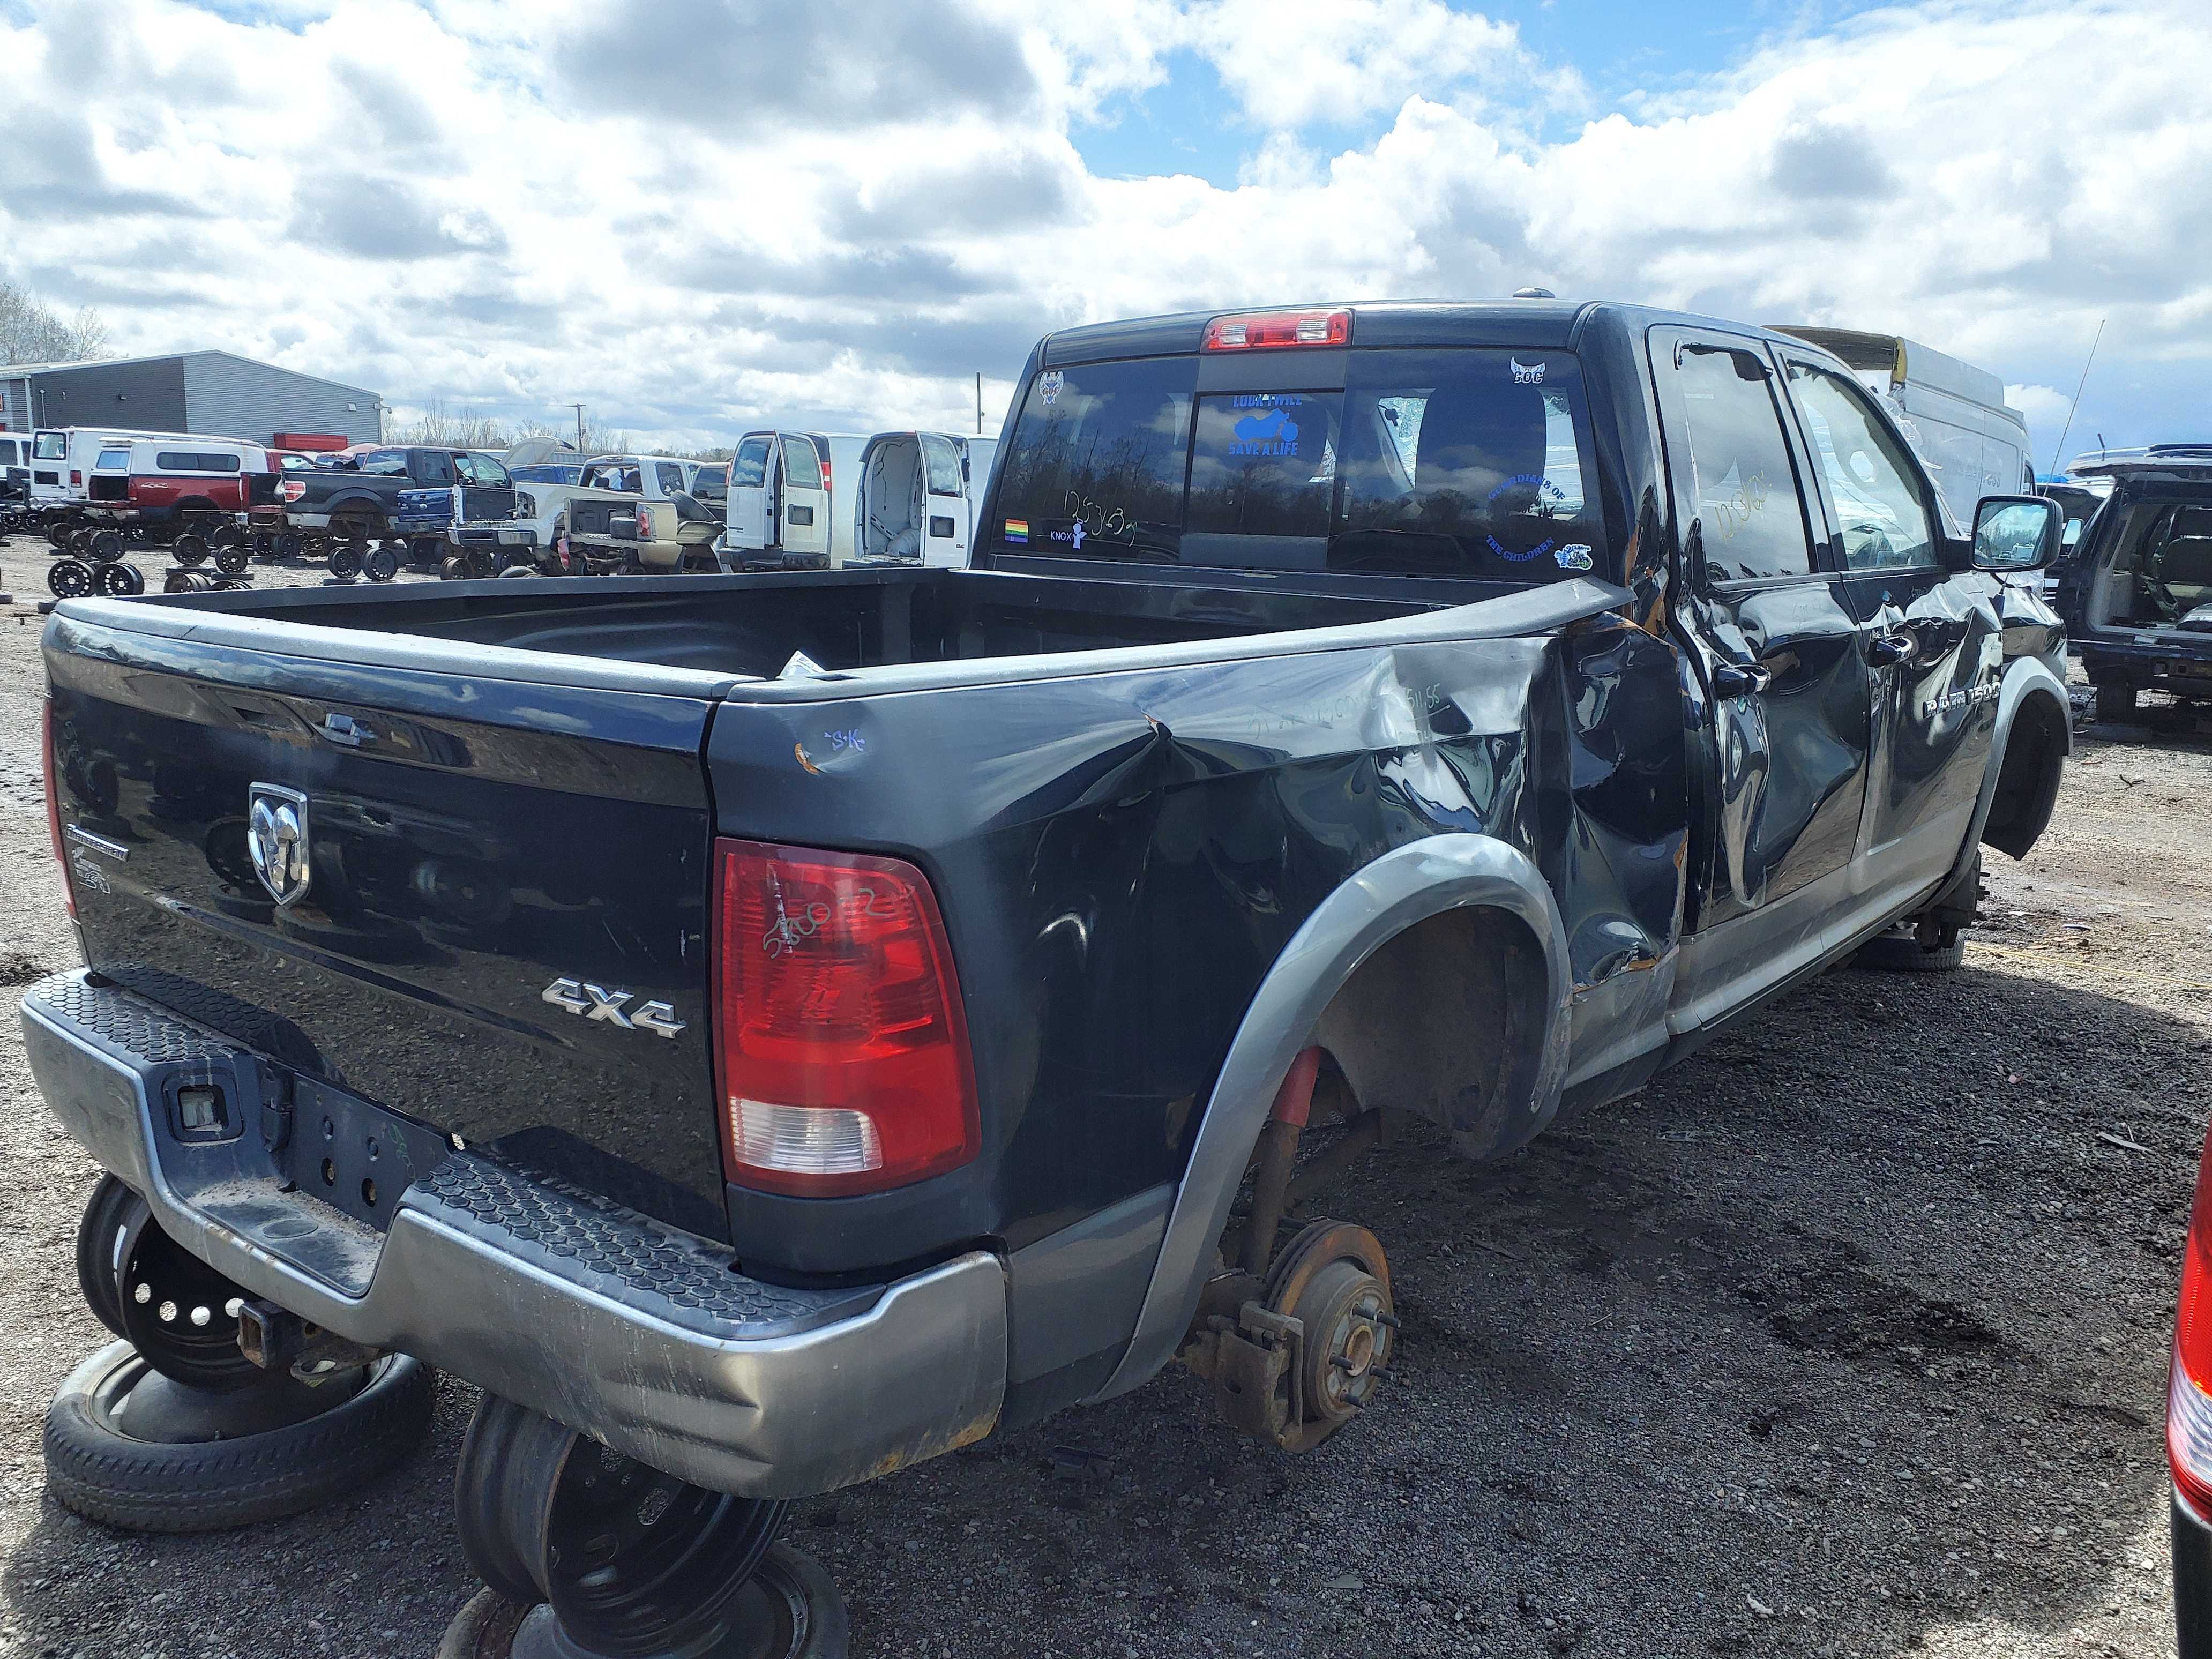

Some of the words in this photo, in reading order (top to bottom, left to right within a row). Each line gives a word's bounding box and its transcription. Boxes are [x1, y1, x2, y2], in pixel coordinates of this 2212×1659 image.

[1234, 394, 1263, 407] LOOK
[1229, 442, 1259, 455] SAVE
[1262, 442, 1271, 455] A
[1273, 442, 1298, 455] LIFE
[1488, 474, 1552, 500] GUARDIANS
[1552, 487, 1566, 500] OF
[1050, 530, 1072, 542] KNOX
[1486, 534, 1503, 555] THE
[1503, 536, 1555, 562] CHILDREN
